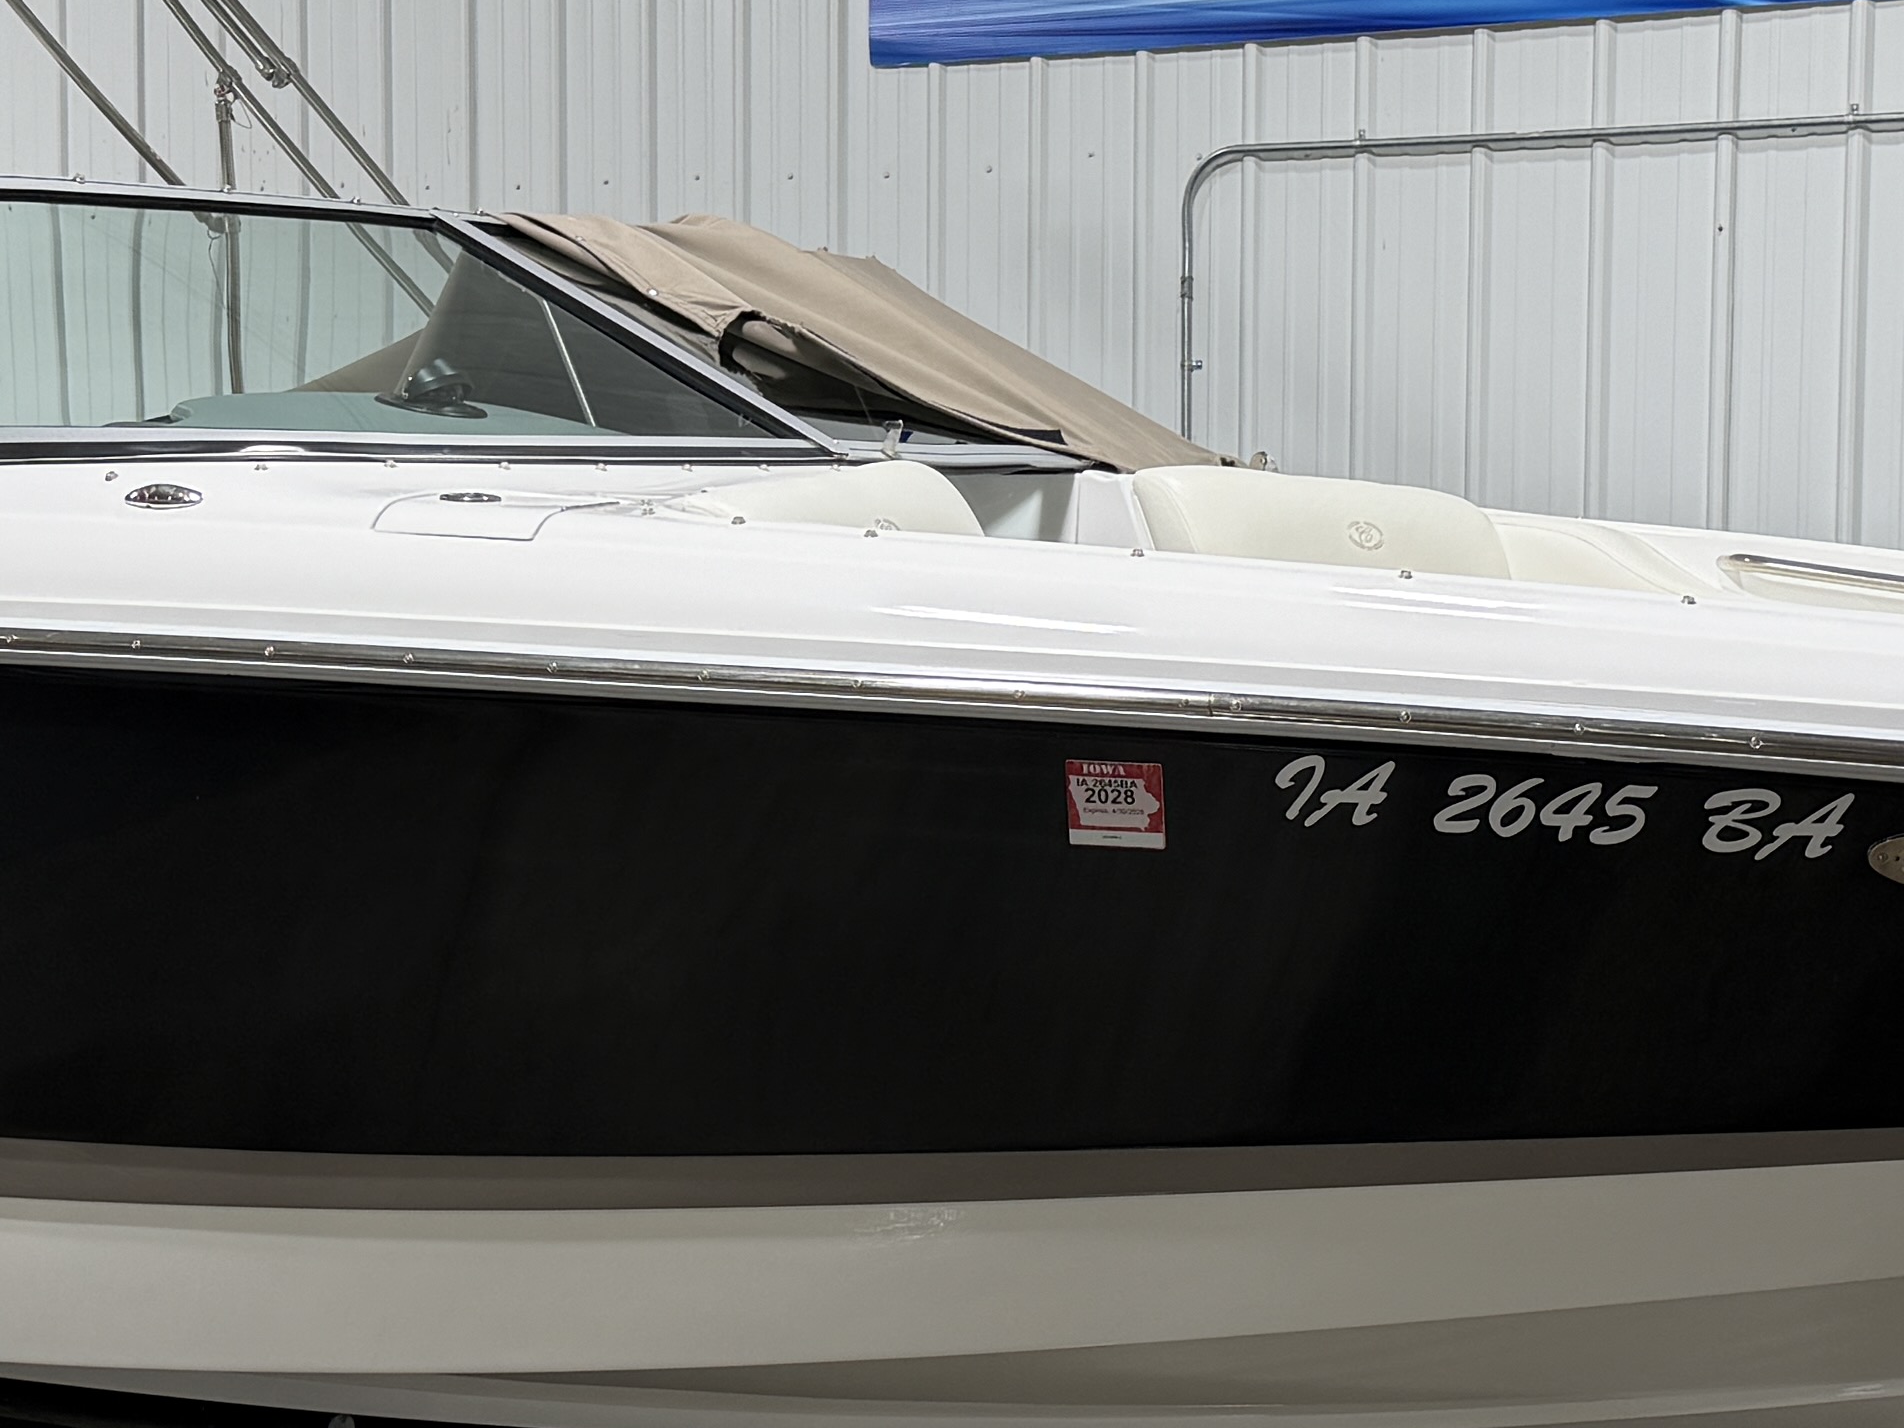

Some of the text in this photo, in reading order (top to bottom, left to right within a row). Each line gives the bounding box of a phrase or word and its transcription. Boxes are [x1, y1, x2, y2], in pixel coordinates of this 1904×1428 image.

[1082, 763, 1127, 776] IOWA
[1076, 777, 1089, 787] IA
[1084, 787, 1136, 806] 2028
[1274, 754, 1856, 861] IA 2645 BA
